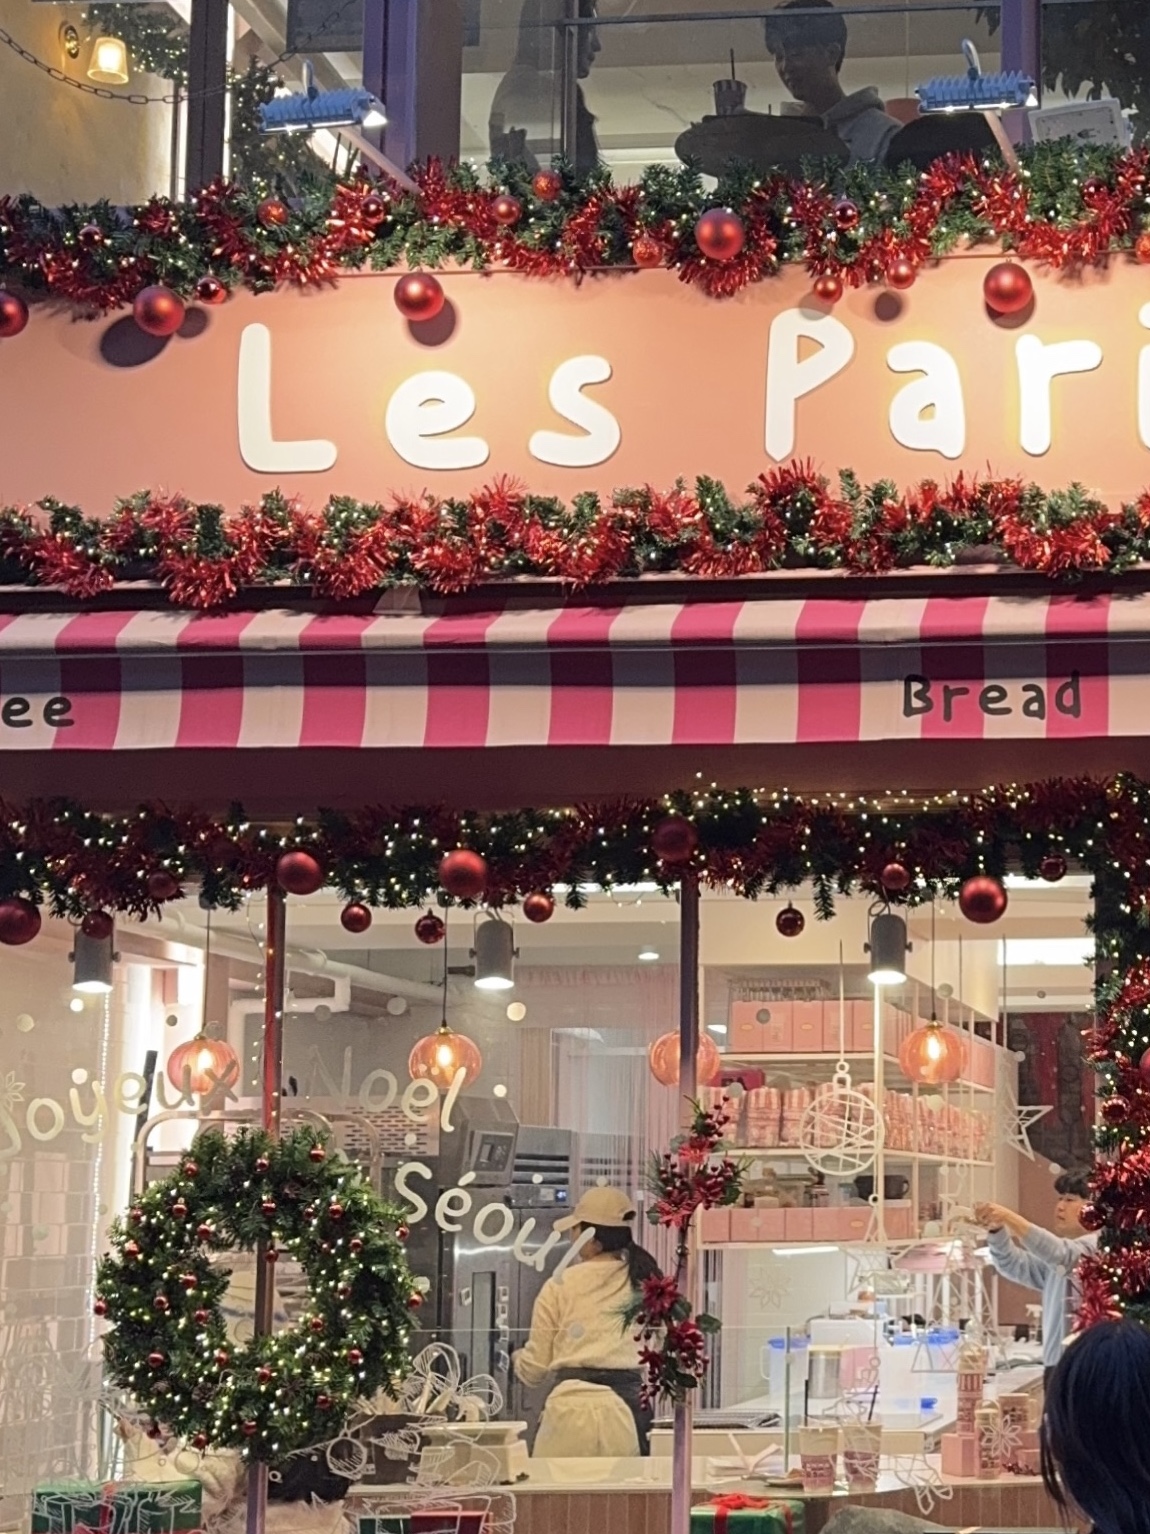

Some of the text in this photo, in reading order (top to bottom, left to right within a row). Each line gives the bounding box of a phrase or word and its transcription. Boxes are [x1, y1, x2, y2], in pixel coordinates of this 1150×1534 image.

[237, 322, 622, 474] Les
[903, 670, 1081, 722] Bread
[395, 1162, 596, 1284] Séoul
